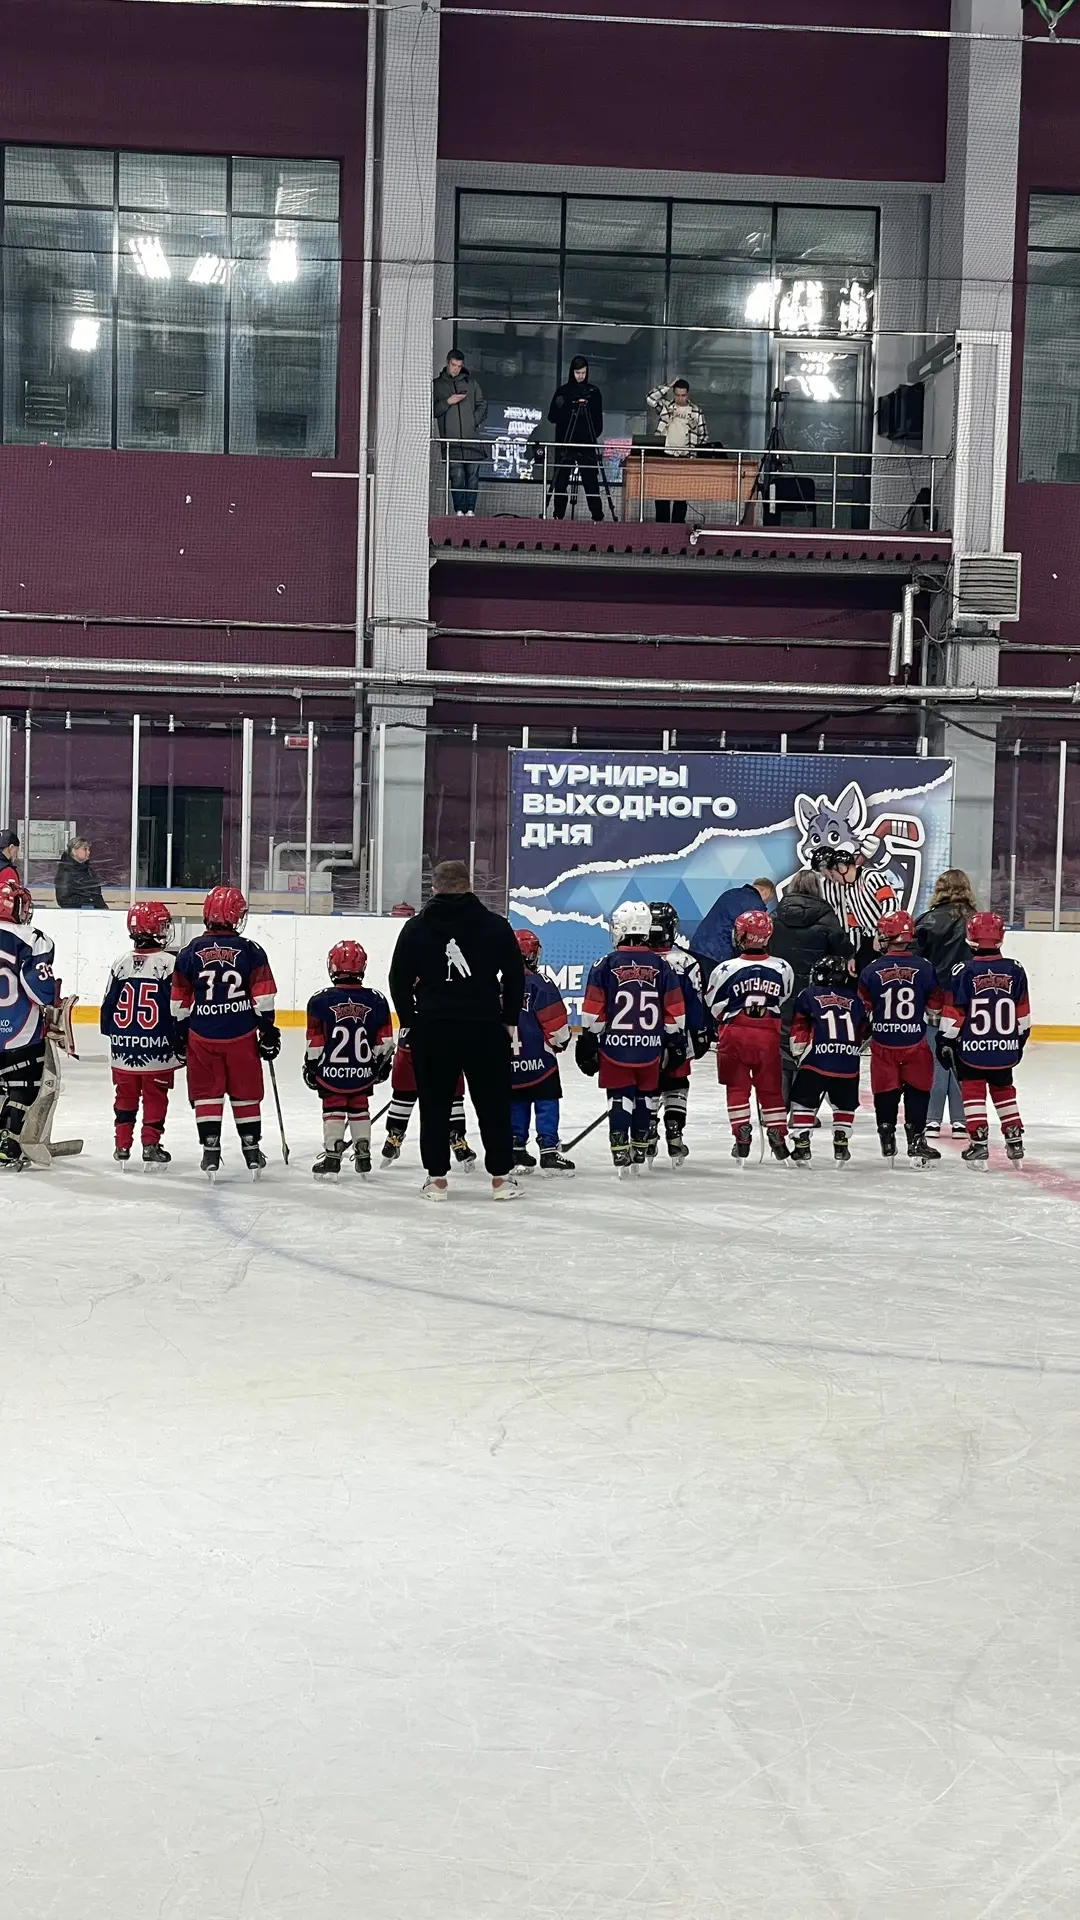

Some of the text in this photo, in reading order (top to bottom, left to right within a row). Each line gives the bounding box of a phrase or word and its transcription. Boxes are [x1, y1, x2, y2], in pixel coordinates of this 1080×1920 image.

[523, 764, 688, 788] ТУРНИРЫ
[522, 793, 738, 820] ВЫХОДНОГО
[521, 823, 593, 848] ДНЯ
[198, 970, 246, 1001] 72
[113, 981, 160, 1031] 95
[196, 999, 252, 1016] КОСТРОМА
[610, 990, 659, 1031] 25
[880, 987, 915, 1020] 18
[970, 997, 1016, 1036] 50
[820, 1010, 855, 1041] 11
[872, 1022, 922, 1034] КОСТРОМА
[110, 1034, 170, 1049] ОСТРОМА
[329, 1026, 373, 1064] 26
[605, 1034, 662, 1048] КОСТРОМА
[962, 1039, 1020, 1052] КОСТРОМА
